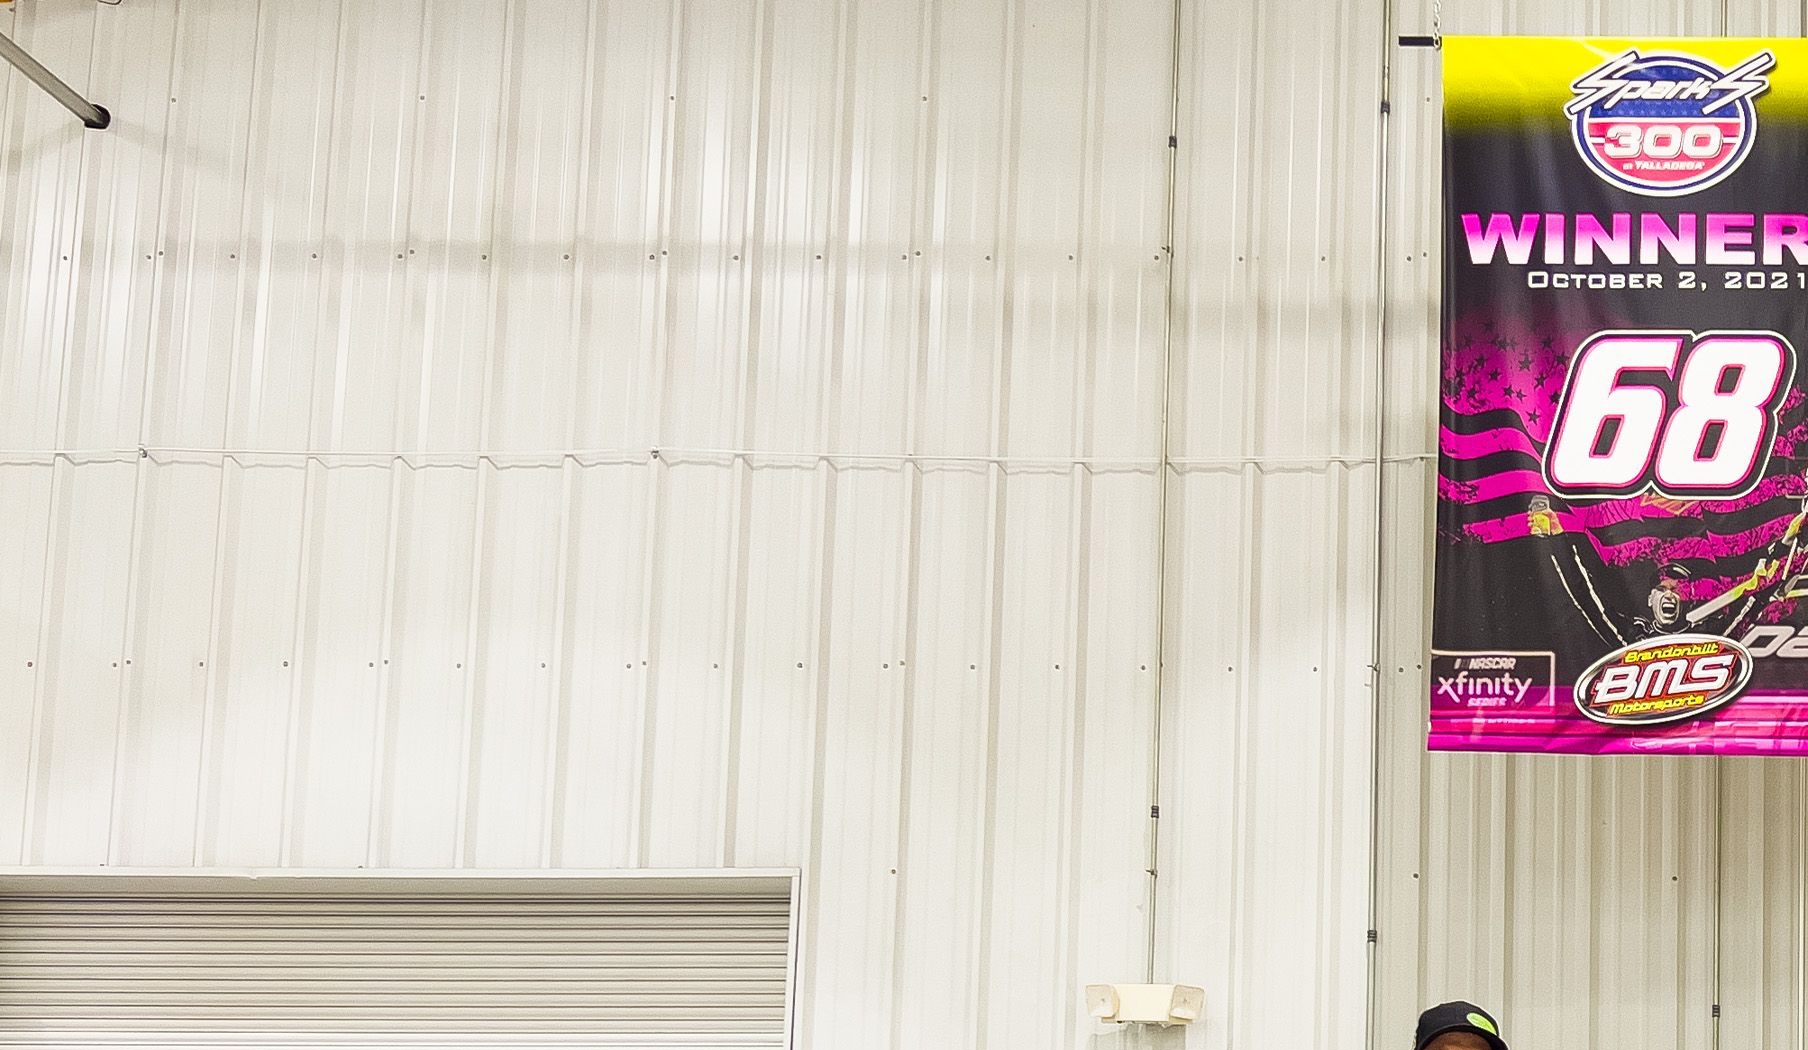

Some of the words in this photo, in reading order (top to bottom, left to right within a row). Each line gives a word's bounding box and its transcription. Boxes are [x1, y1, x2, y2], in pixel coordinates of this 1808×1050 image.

[1603, 124, 1723, 159] 300
[1634, 160, 1705, 171] TALLADEGA
[1678, 271, 1708, 291] 2,
[1725, 271, 1807, 289] 2021
[1544, 332, 1794, 495] 68
[1468, 657, 1517, 670] NASCAR
[1437, 671, 1532, 703] xfinity
[1593, 654, 1735, 704] BMS
[1609, 694, 1705, 715] Motorsports
